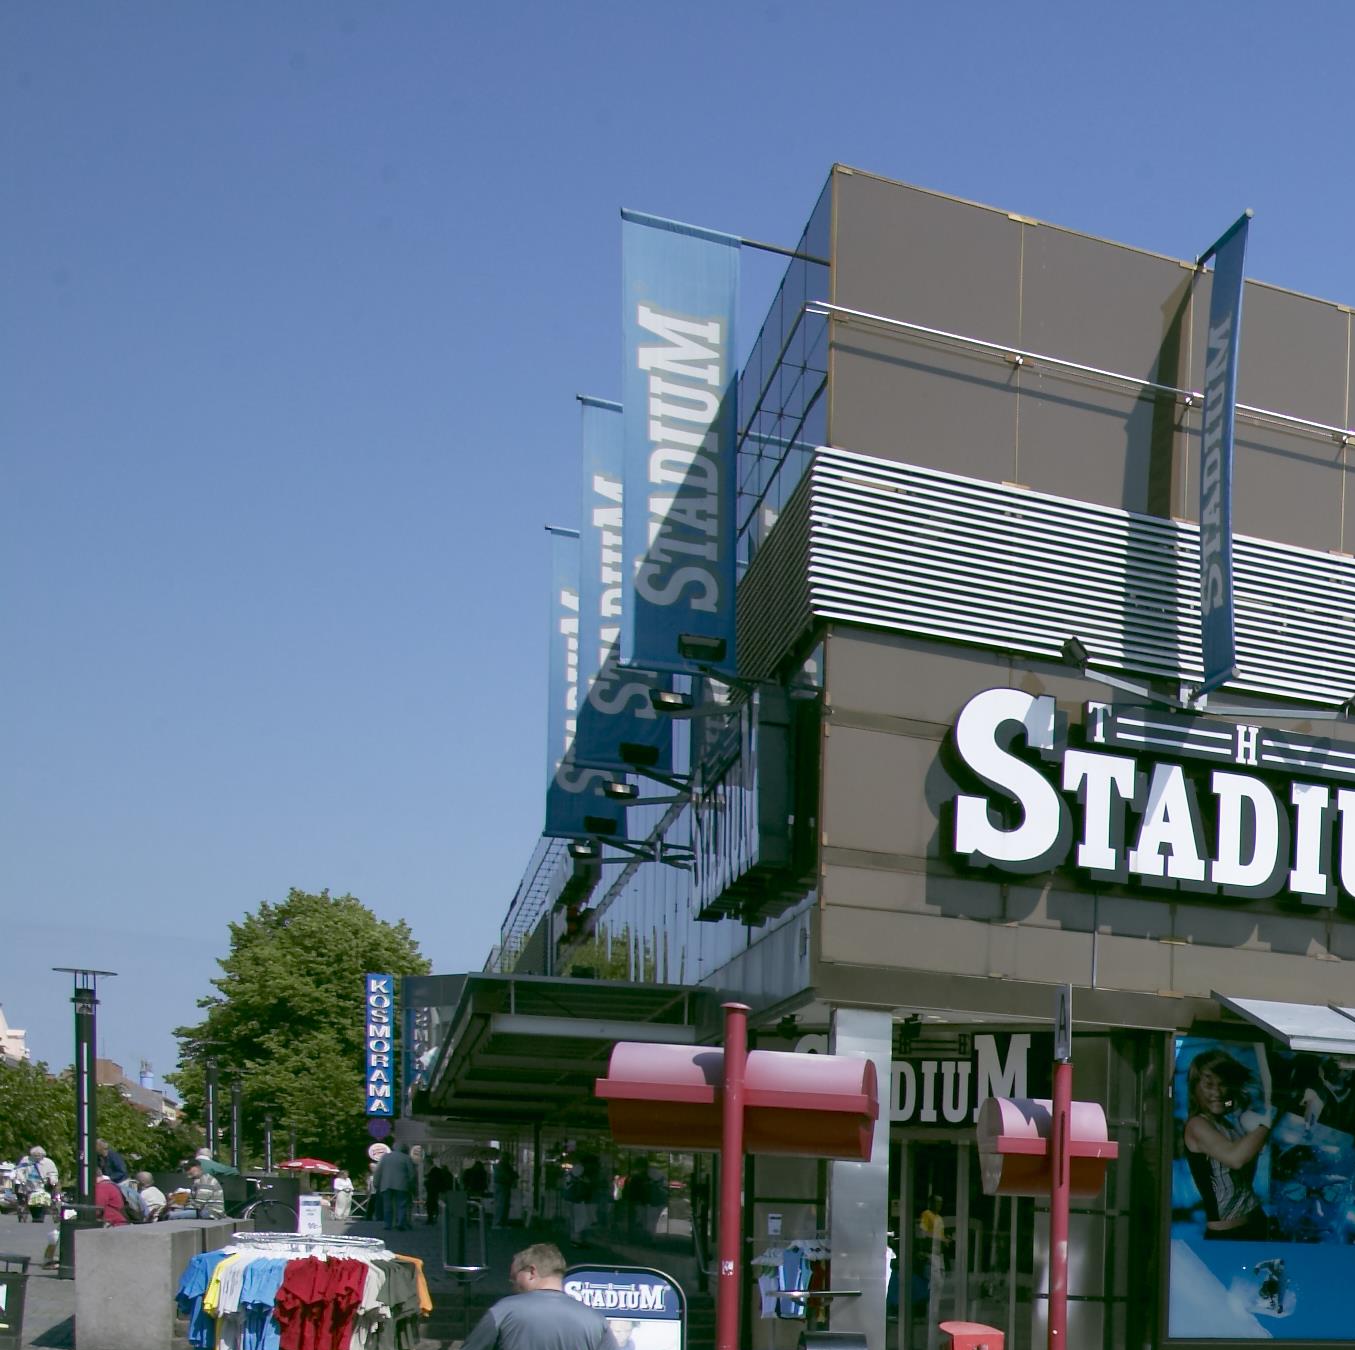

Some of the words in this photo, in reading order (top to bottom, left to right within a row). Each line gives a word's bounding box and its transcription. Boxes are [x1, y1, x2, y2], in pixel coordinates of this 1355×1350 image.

[634, 303, 721, 614] STADIUM
[1200, 311, 1232, 617] STADIUM
[369, 978, 391, 1113] KOSMORAMA
[1058, 993, 1068, 1042] A
